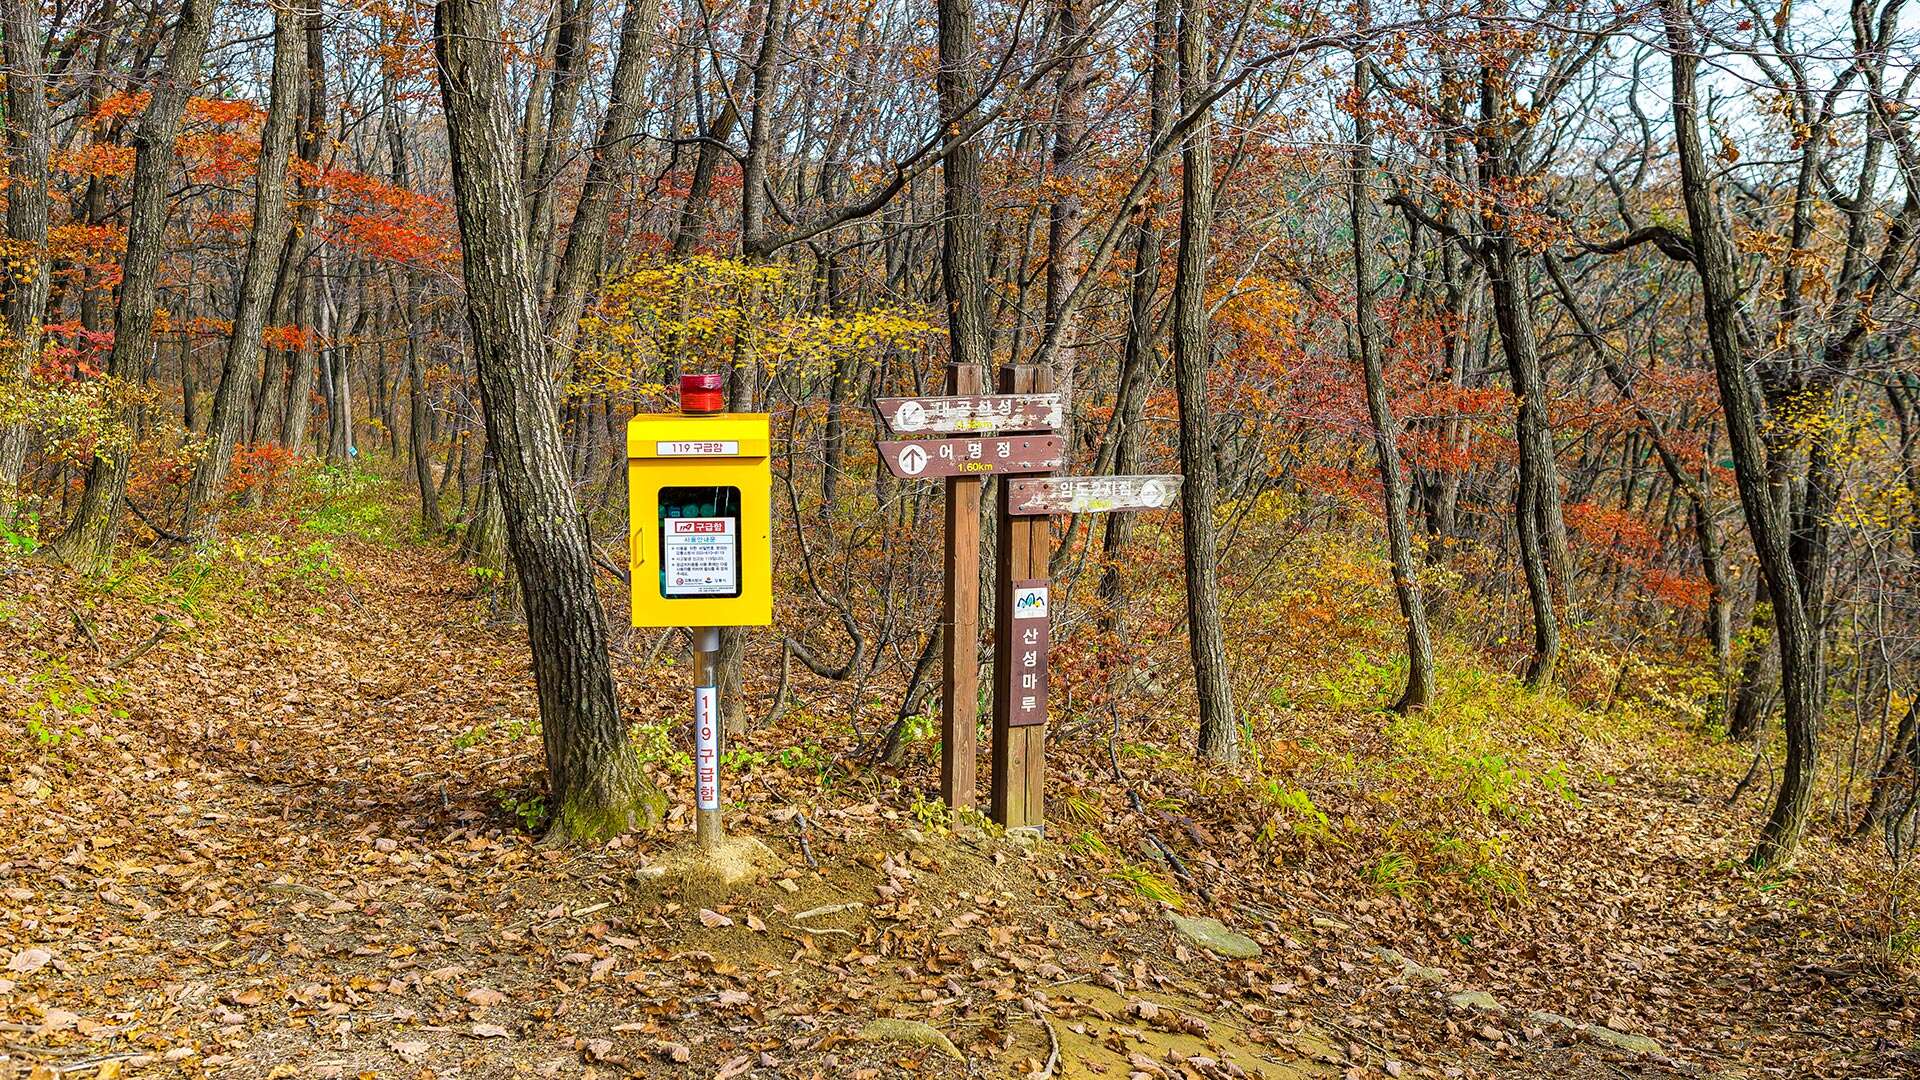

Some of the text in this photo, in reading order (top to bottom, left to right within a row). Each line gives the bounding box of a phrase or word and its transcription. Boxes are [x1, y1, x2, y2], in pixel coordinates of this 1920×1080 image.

[672, 443, 723, 453] 119 구급함
[939, 441, 1010, 460] 어명정
[958, 462, 993, 472] 1.60km
[696, 522, 723, 532] 구급함
[1021, 628, 1039, 712] 산성마루
[700, 695, 714, 802] 119 구급함
